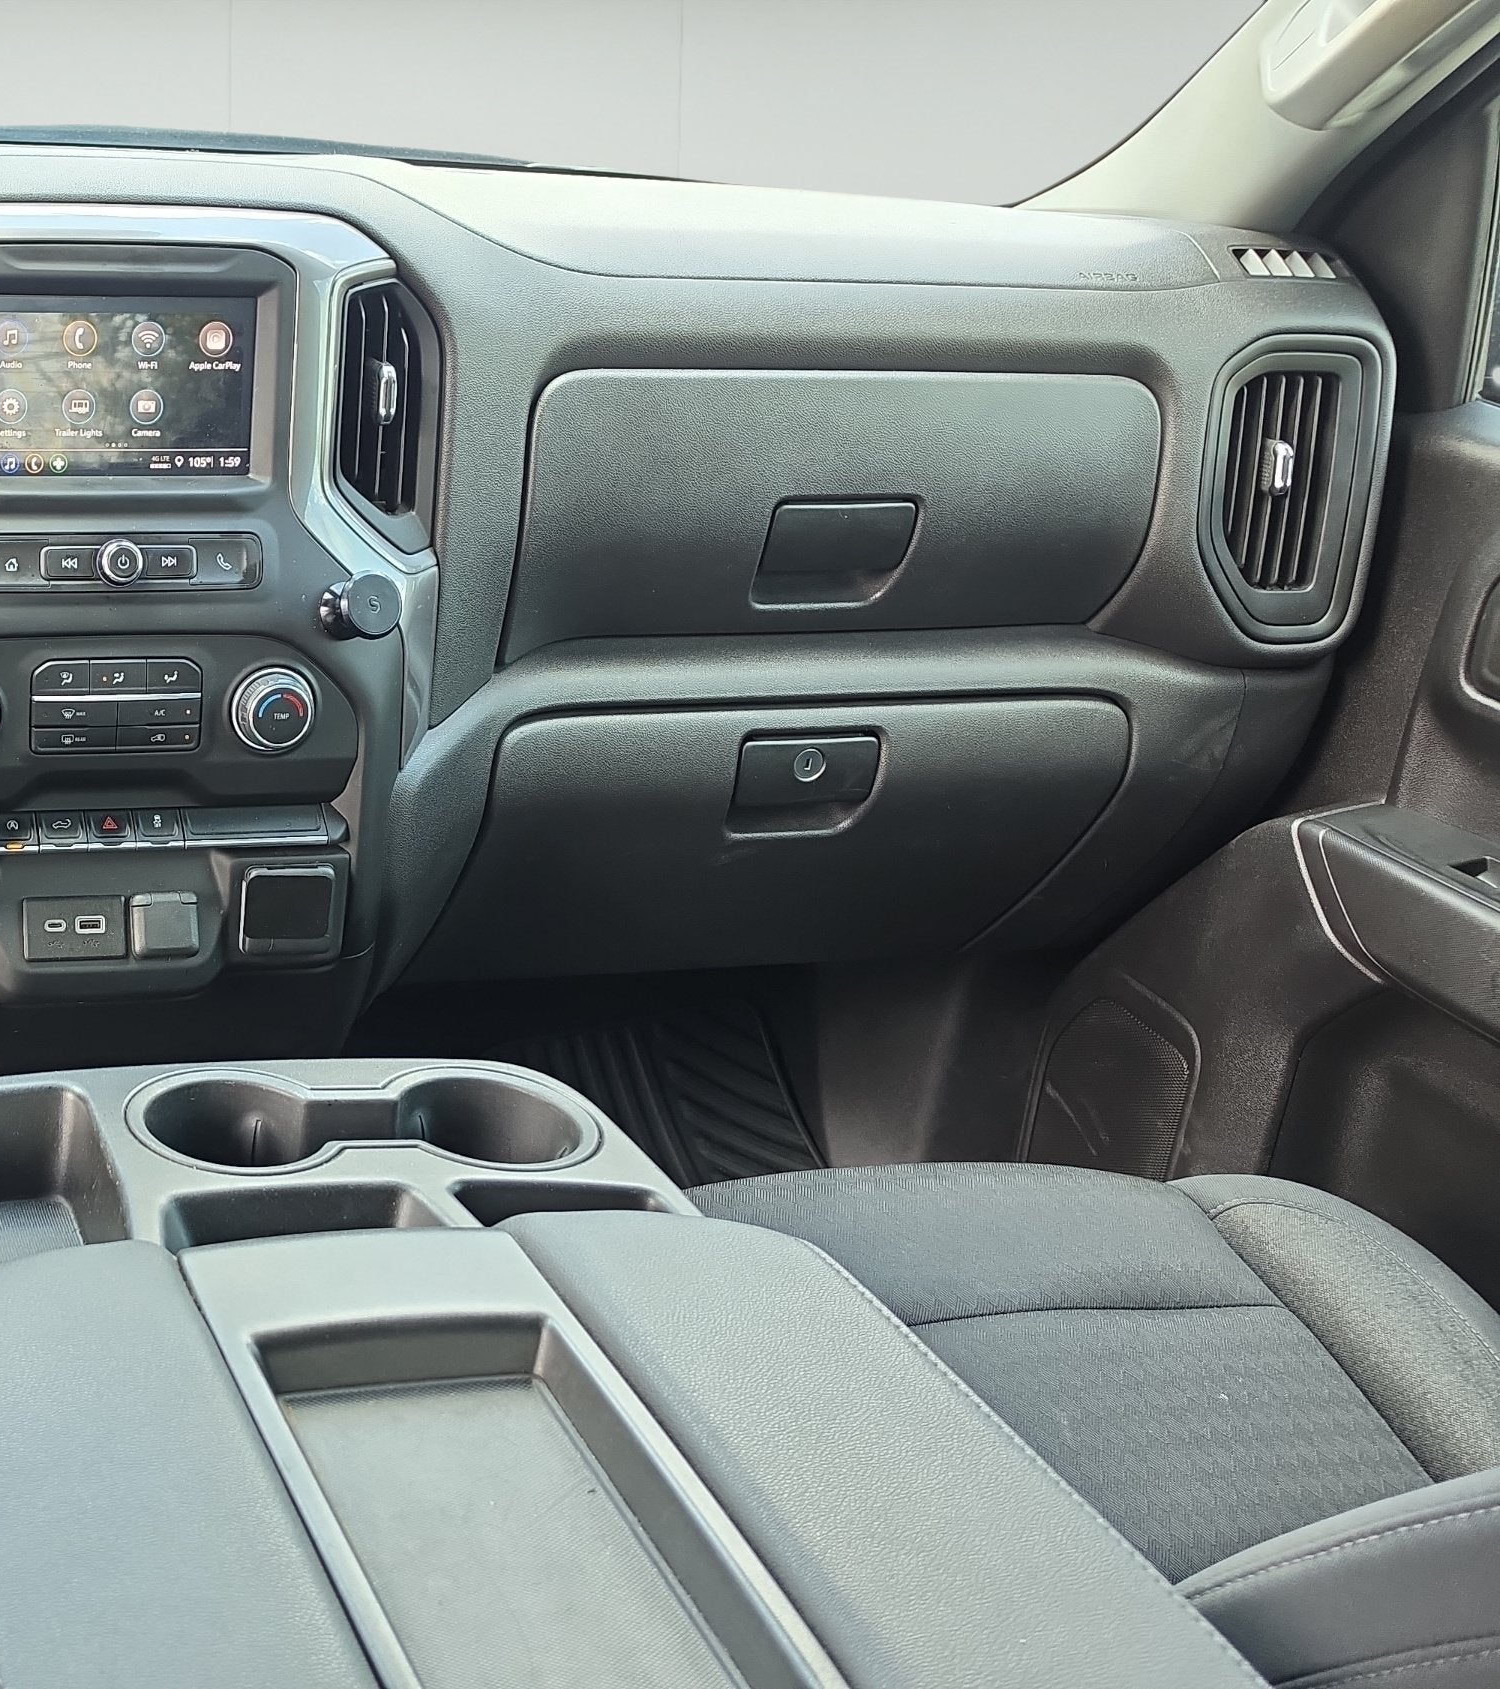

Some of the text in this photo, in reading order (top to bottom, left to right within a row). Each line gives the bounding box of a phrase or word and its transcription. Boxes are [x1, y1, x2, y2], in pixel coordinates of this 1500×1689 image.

[1078, 272, 1138, 282] AIRBAG
[0, 360, 22, 369] Audio
[67, 360, 92, 369] Phone
[137, 360, 158, 370] Wi-Fi
[188, 361, 241, 372] Apple CarPlay
[55, 428, 103, 439] Trailer Lights
[131, 428, 161, 437] Camera
[218, 456, 242, 468] 1:59
[154, 709, 166, 717] A/C
